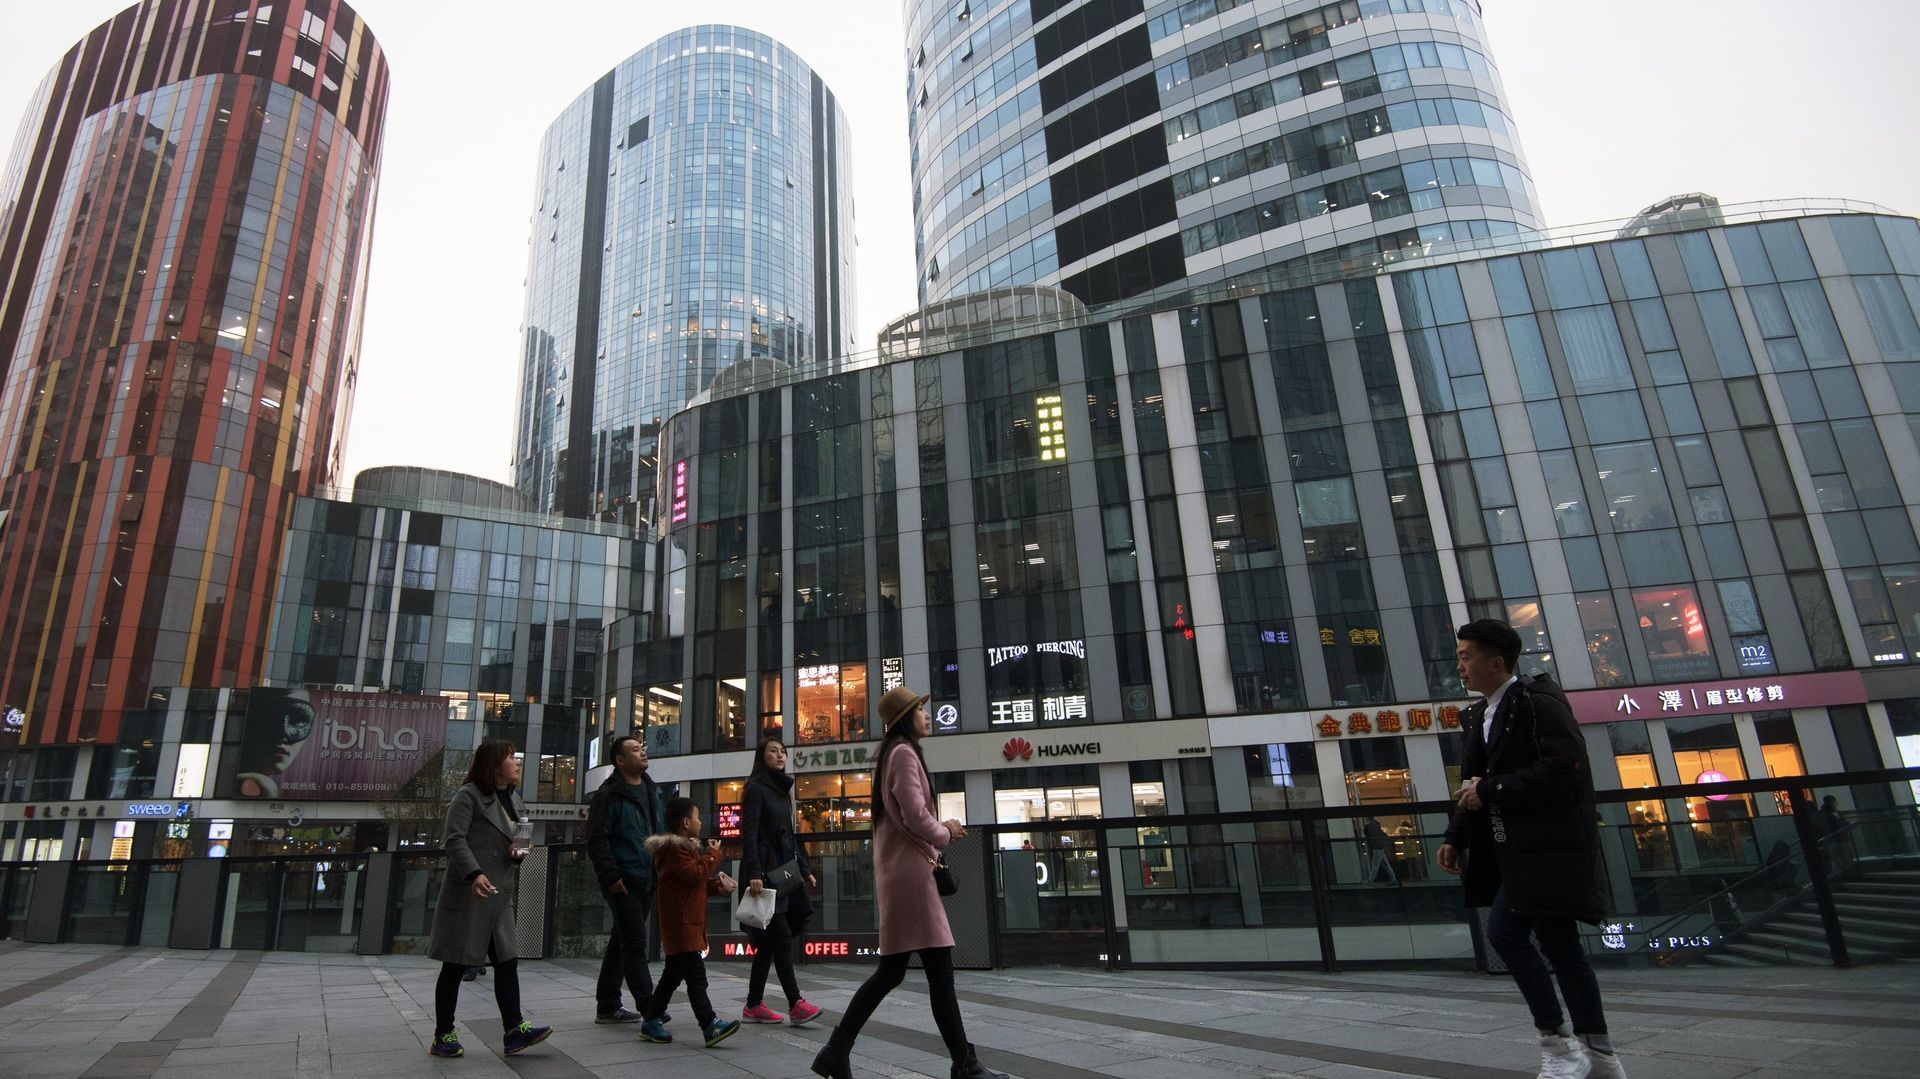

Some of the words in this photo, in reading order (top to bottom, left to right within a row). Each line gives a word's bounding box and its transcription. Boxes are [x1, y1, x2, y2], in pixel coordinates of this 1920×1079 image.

[988, 645, 1028, 667] TATTOO
[1037, 640, 1085, 659] PIERCING
[1741, 645, 1767, 657] m2
[1706, 684, 1785, 706] 眉型修剪
[991, 699, 1035, 725] 王雷
[1042, 695, 1087, 721] 刺青
[1317, 705, 1461, 737] 金典鲍师傅
[322, 718, 419, 751] ibiza
[1038, 742, 1102, 758] HUAWEI
[128, 803, 172, 815] sweeo
[288, 806, 304, 827] 3
[725, 943, 758, 956] MAA
[804, 942, 849, 956] OFFEE
[1668, 936, 1711, 948] PLUS
